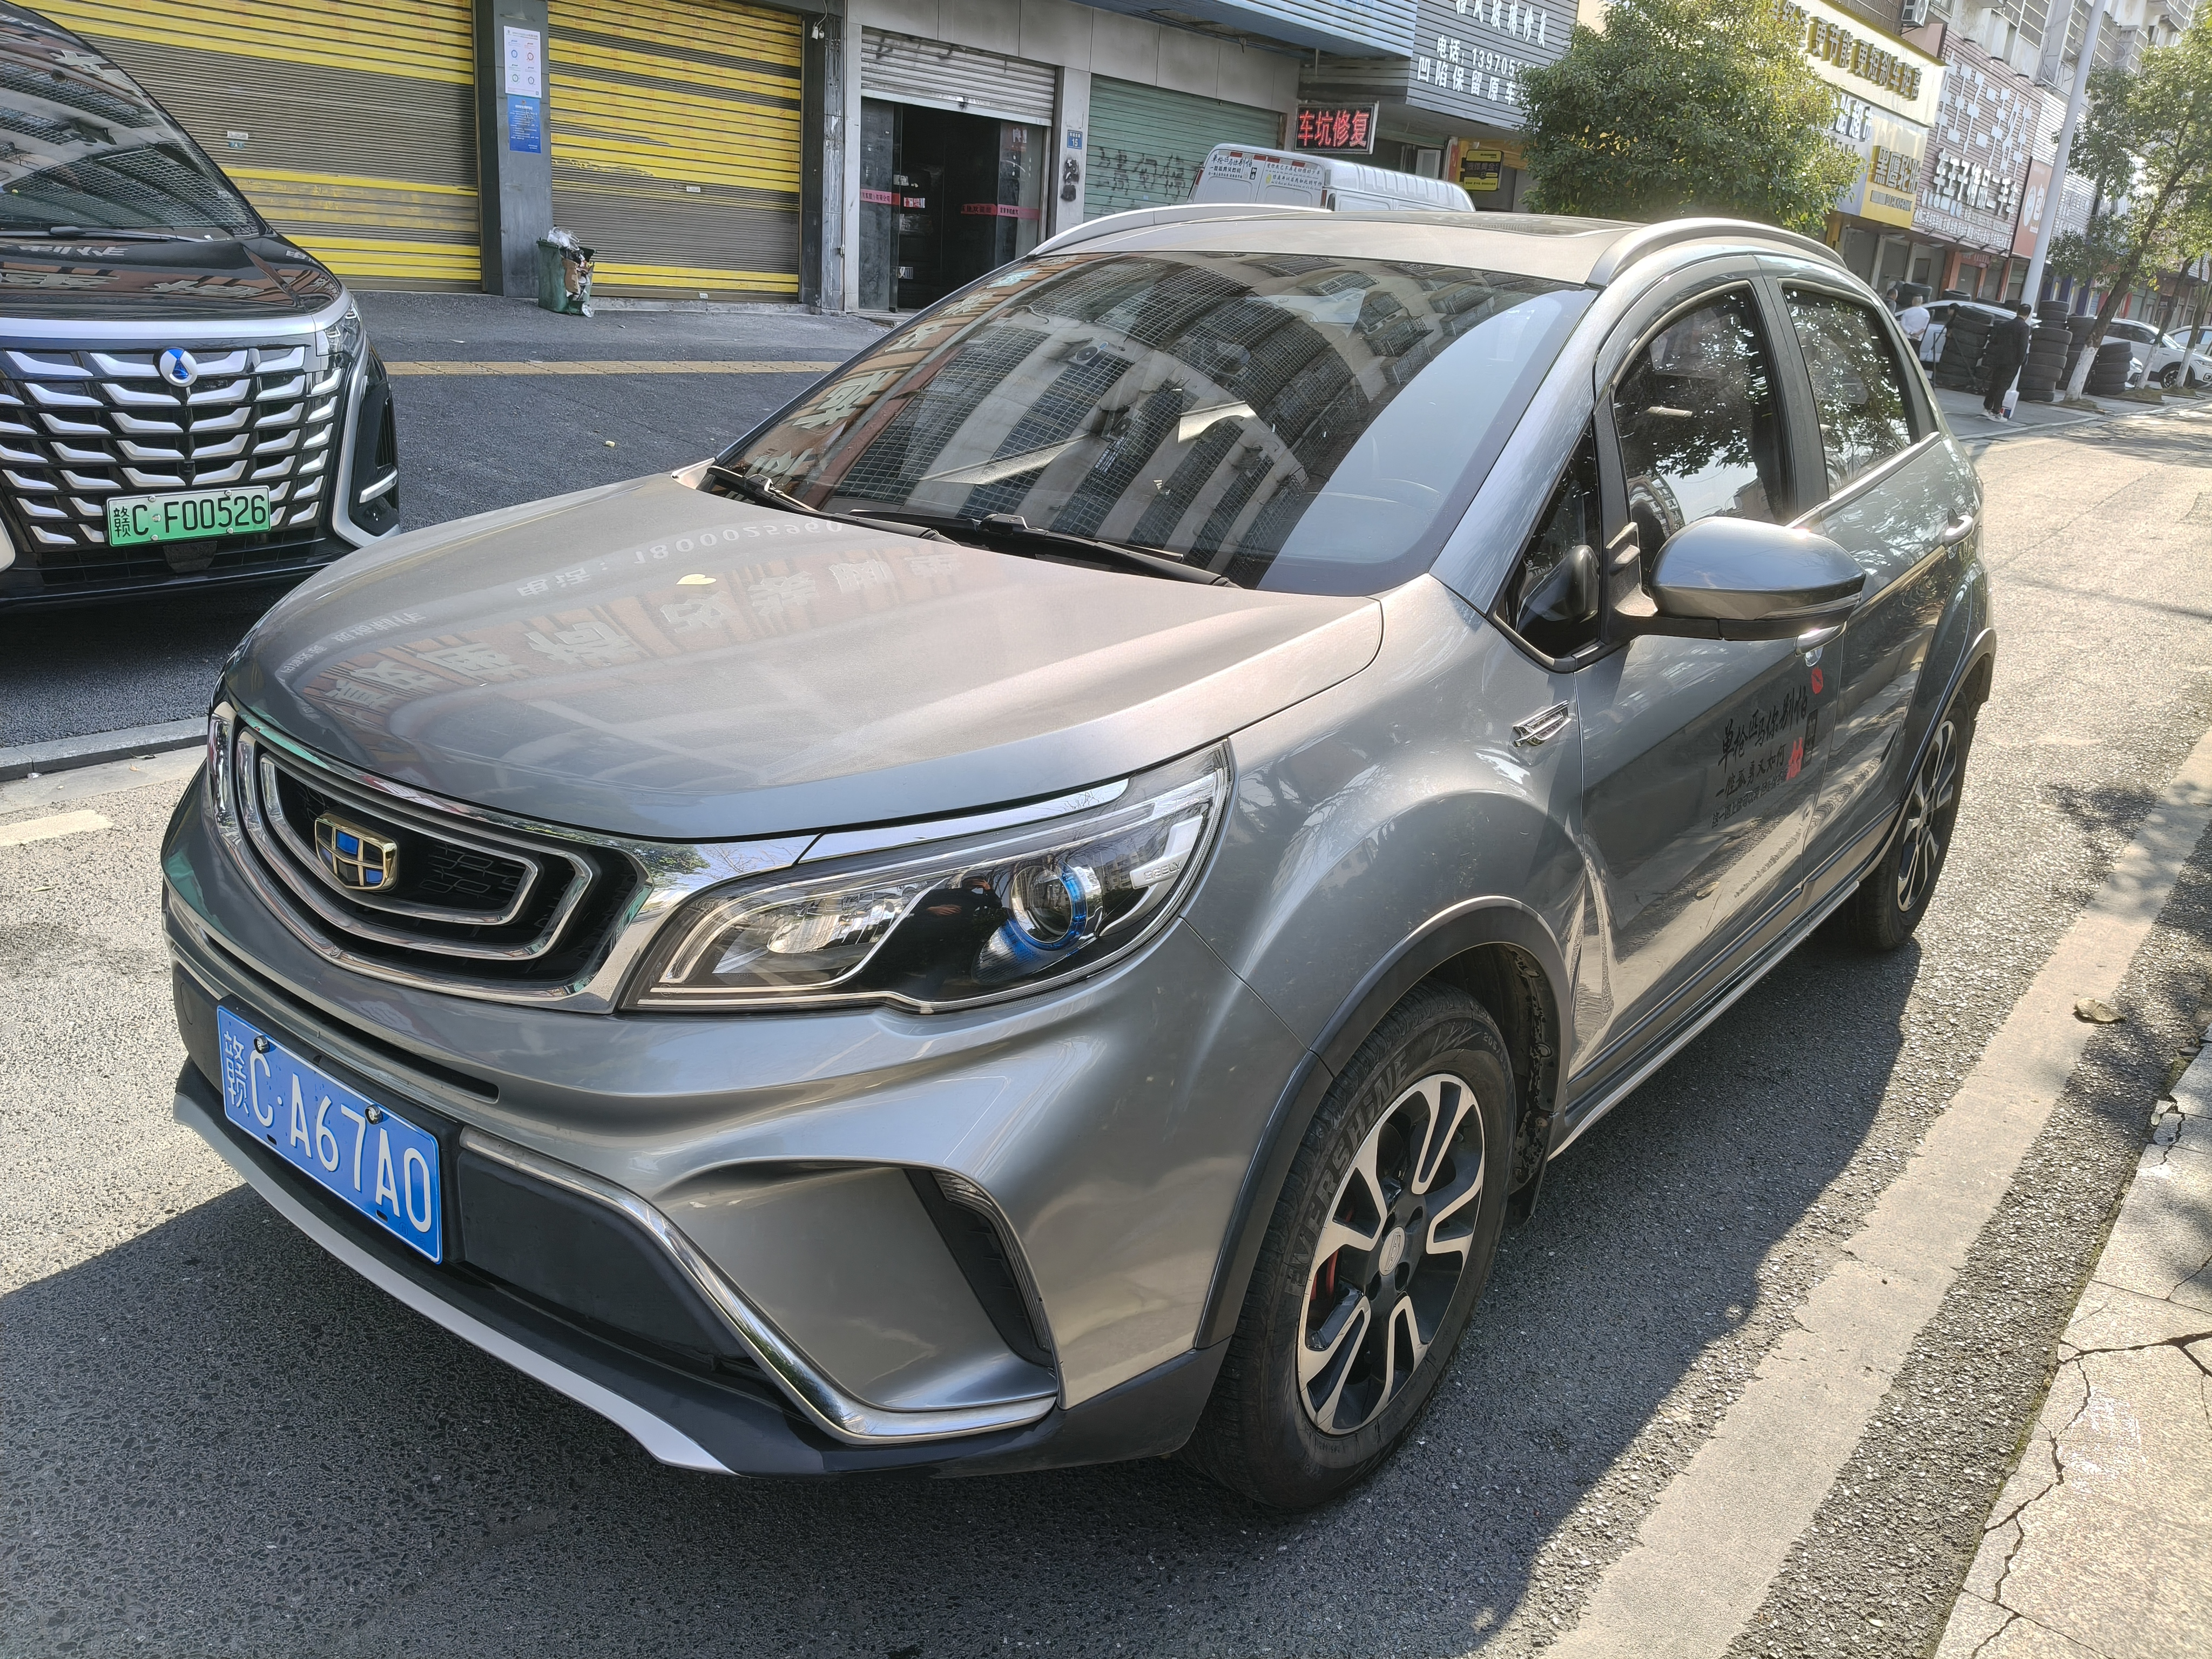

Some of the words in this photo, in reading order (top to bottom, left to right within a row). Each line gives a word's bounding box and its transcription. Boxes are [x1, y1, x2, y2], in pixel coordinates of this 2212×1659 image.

[1298, 110, 1370, 147] 车坑修复
[1874, 146, 1921, 194] 黑鹰轮胎
[1143, 859, 1182, 881] GEELY
